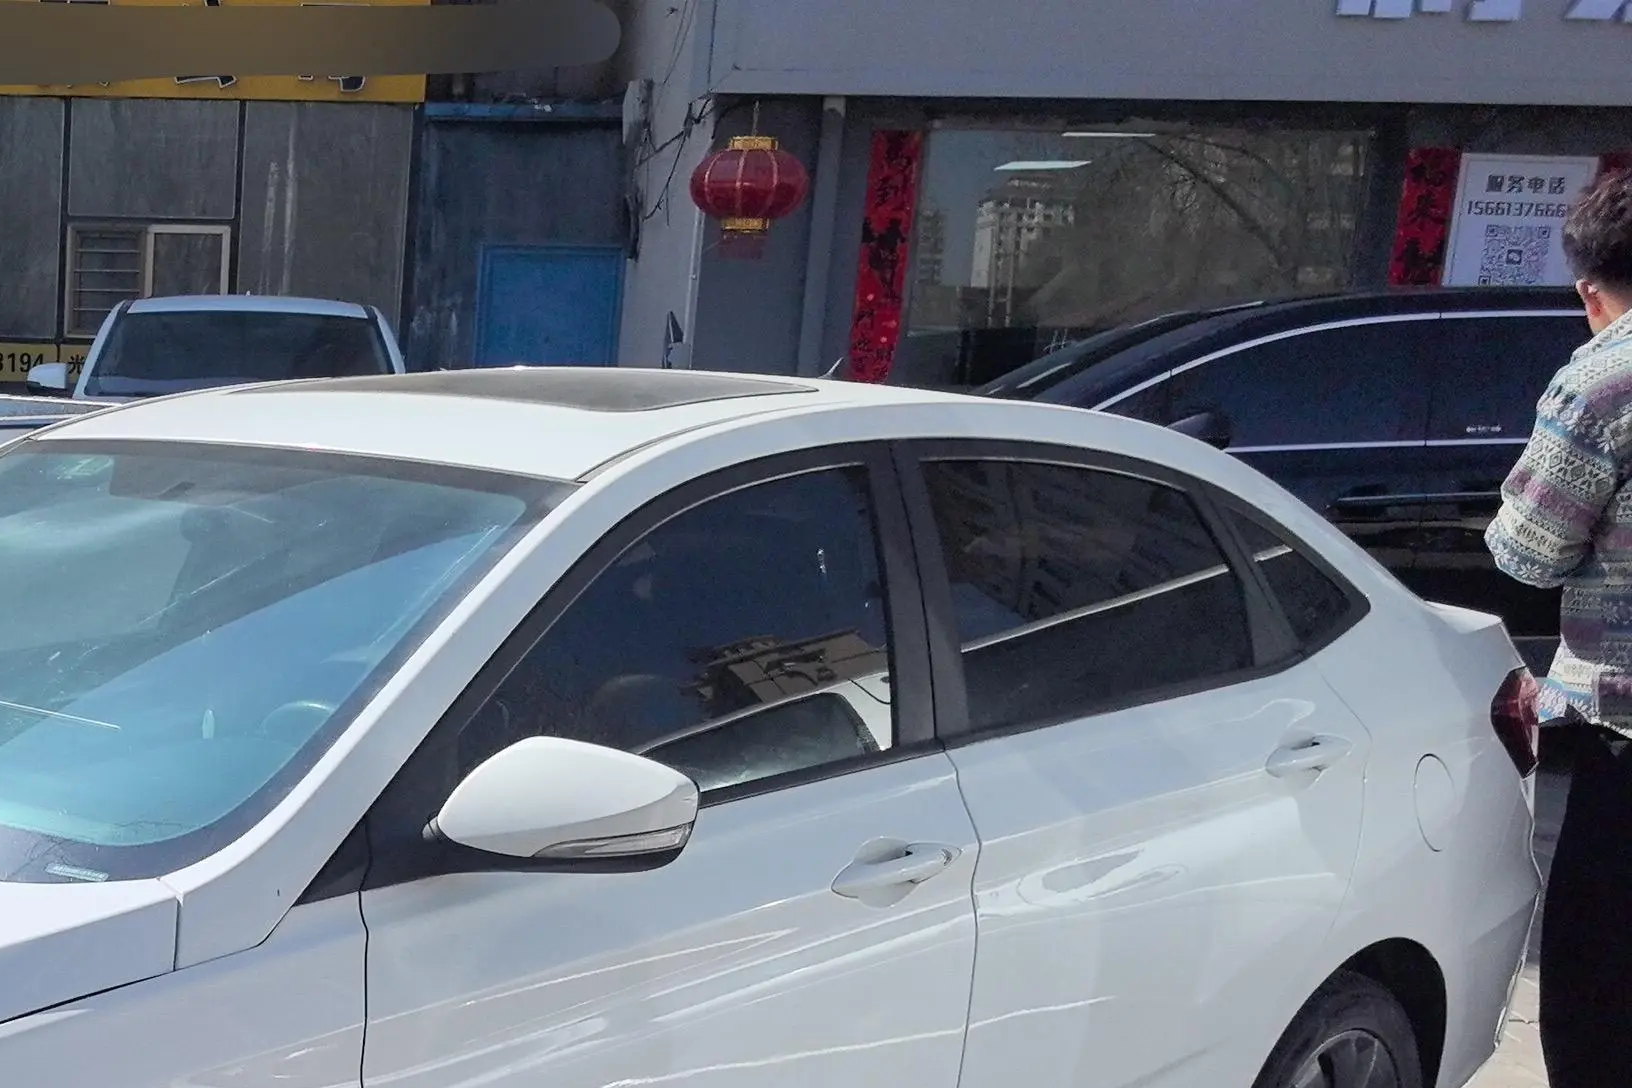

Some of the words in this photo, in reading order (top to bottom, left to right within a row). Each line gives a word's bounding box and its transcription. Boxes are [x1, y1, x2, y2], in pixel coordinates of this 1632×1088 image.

[1486, 174, 1566, 195] 服务电话
[1467, 200, 1572, 218] 1566137666
